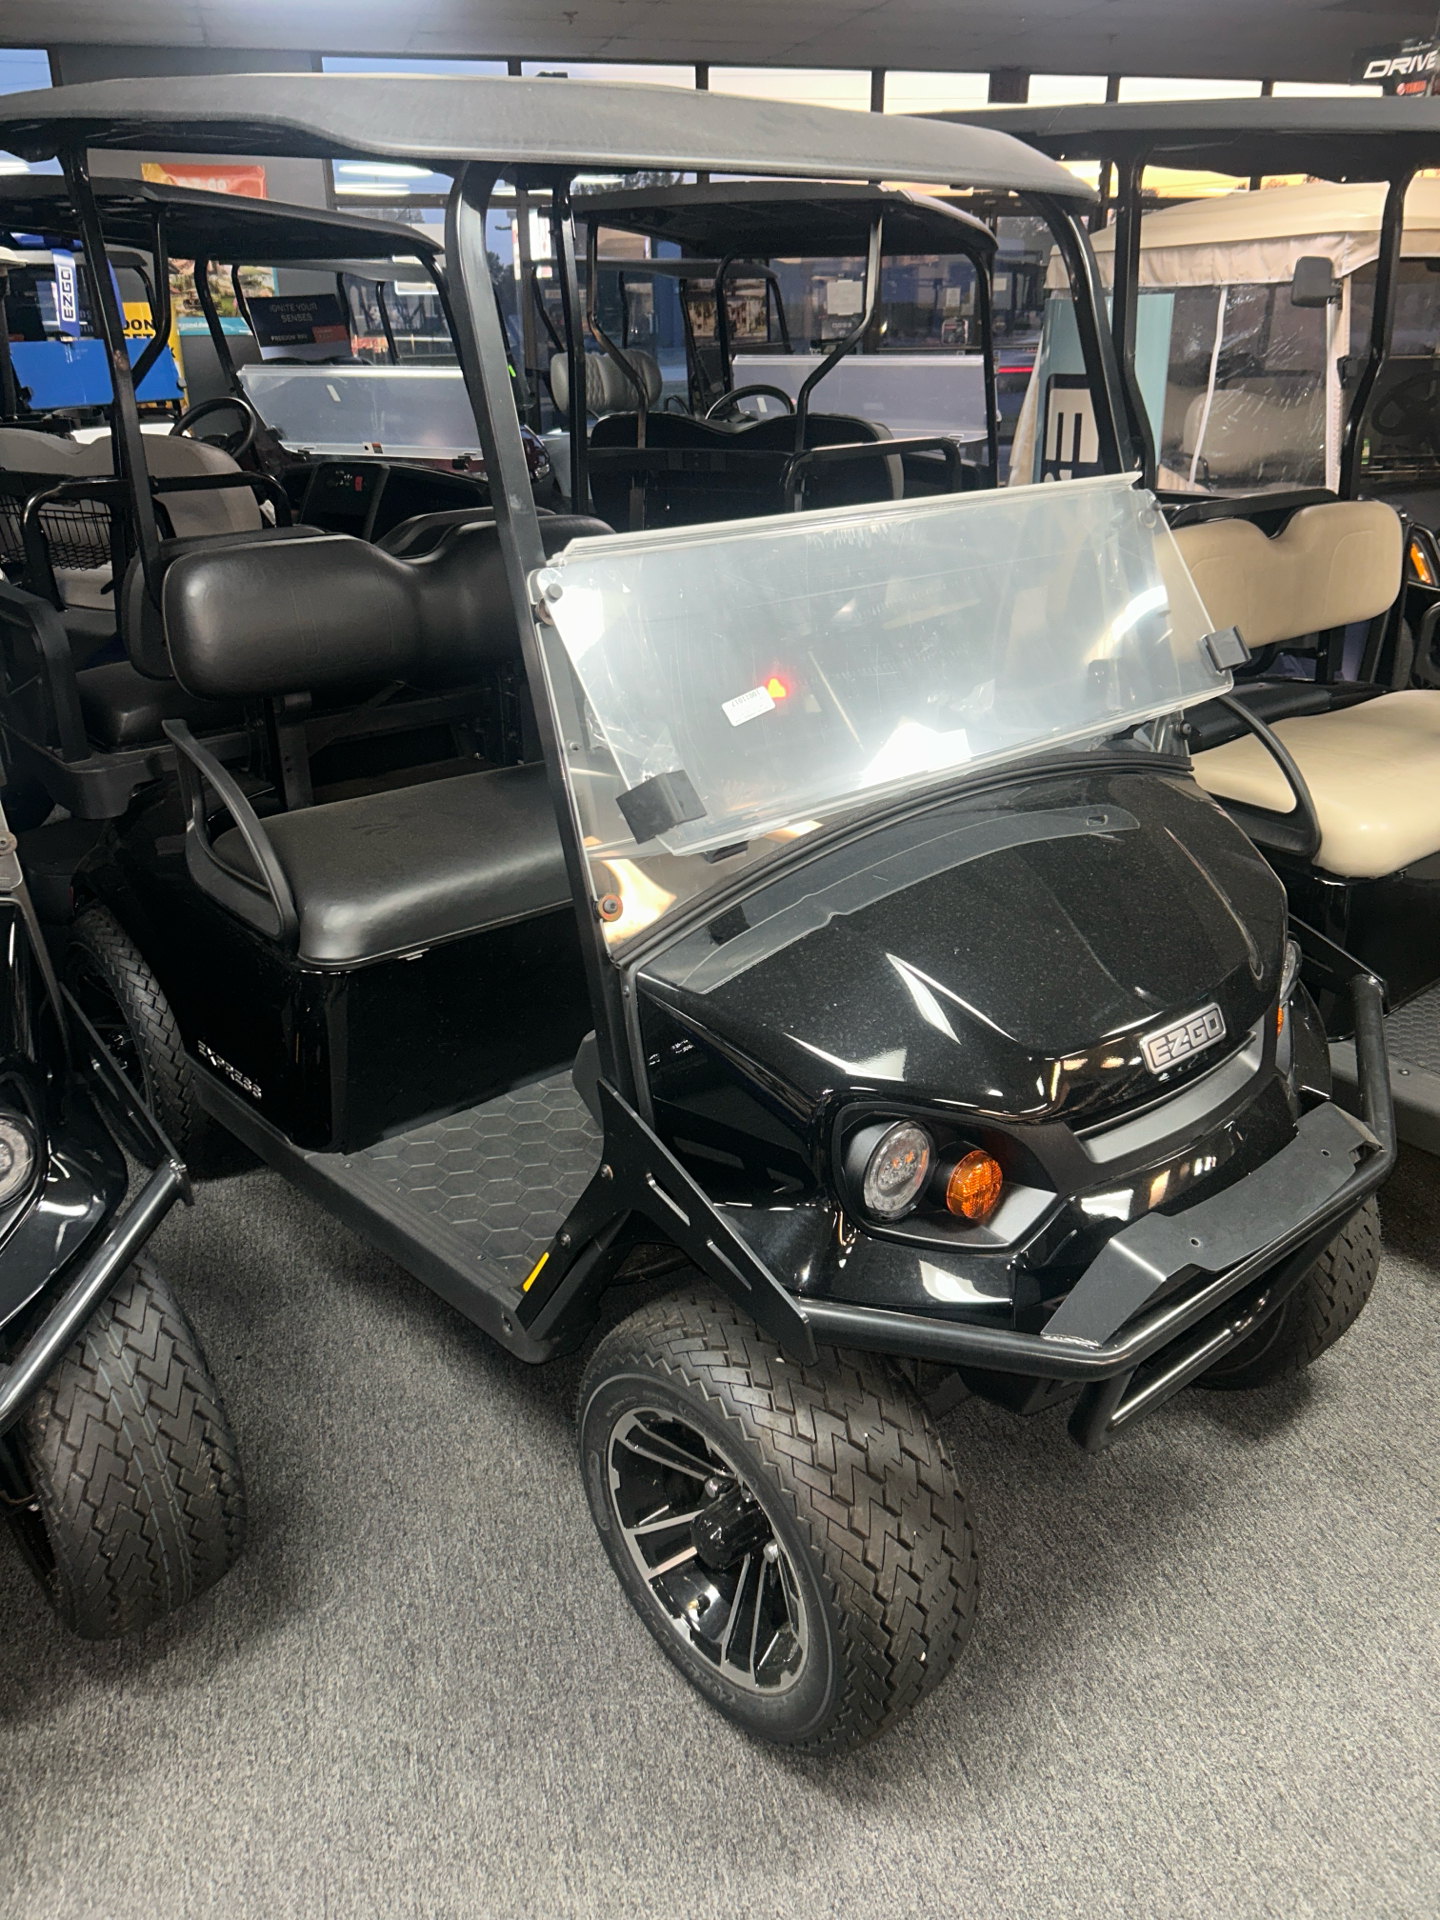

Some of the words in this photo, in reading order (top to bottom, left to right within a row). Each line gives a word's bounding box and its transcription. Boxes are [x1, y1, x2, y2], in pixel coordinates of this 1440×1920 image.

[1363, 50, 1438, 79] DRIVE
[269, 303, 296, 313] IGNITE
[296, 302, 318, 312] YOUR
[280, 313, 313, 323] SENSES
[1148, 1008, 1221, 1067] EZGO
[198, 1040, 262, 1099] EXPRESS
